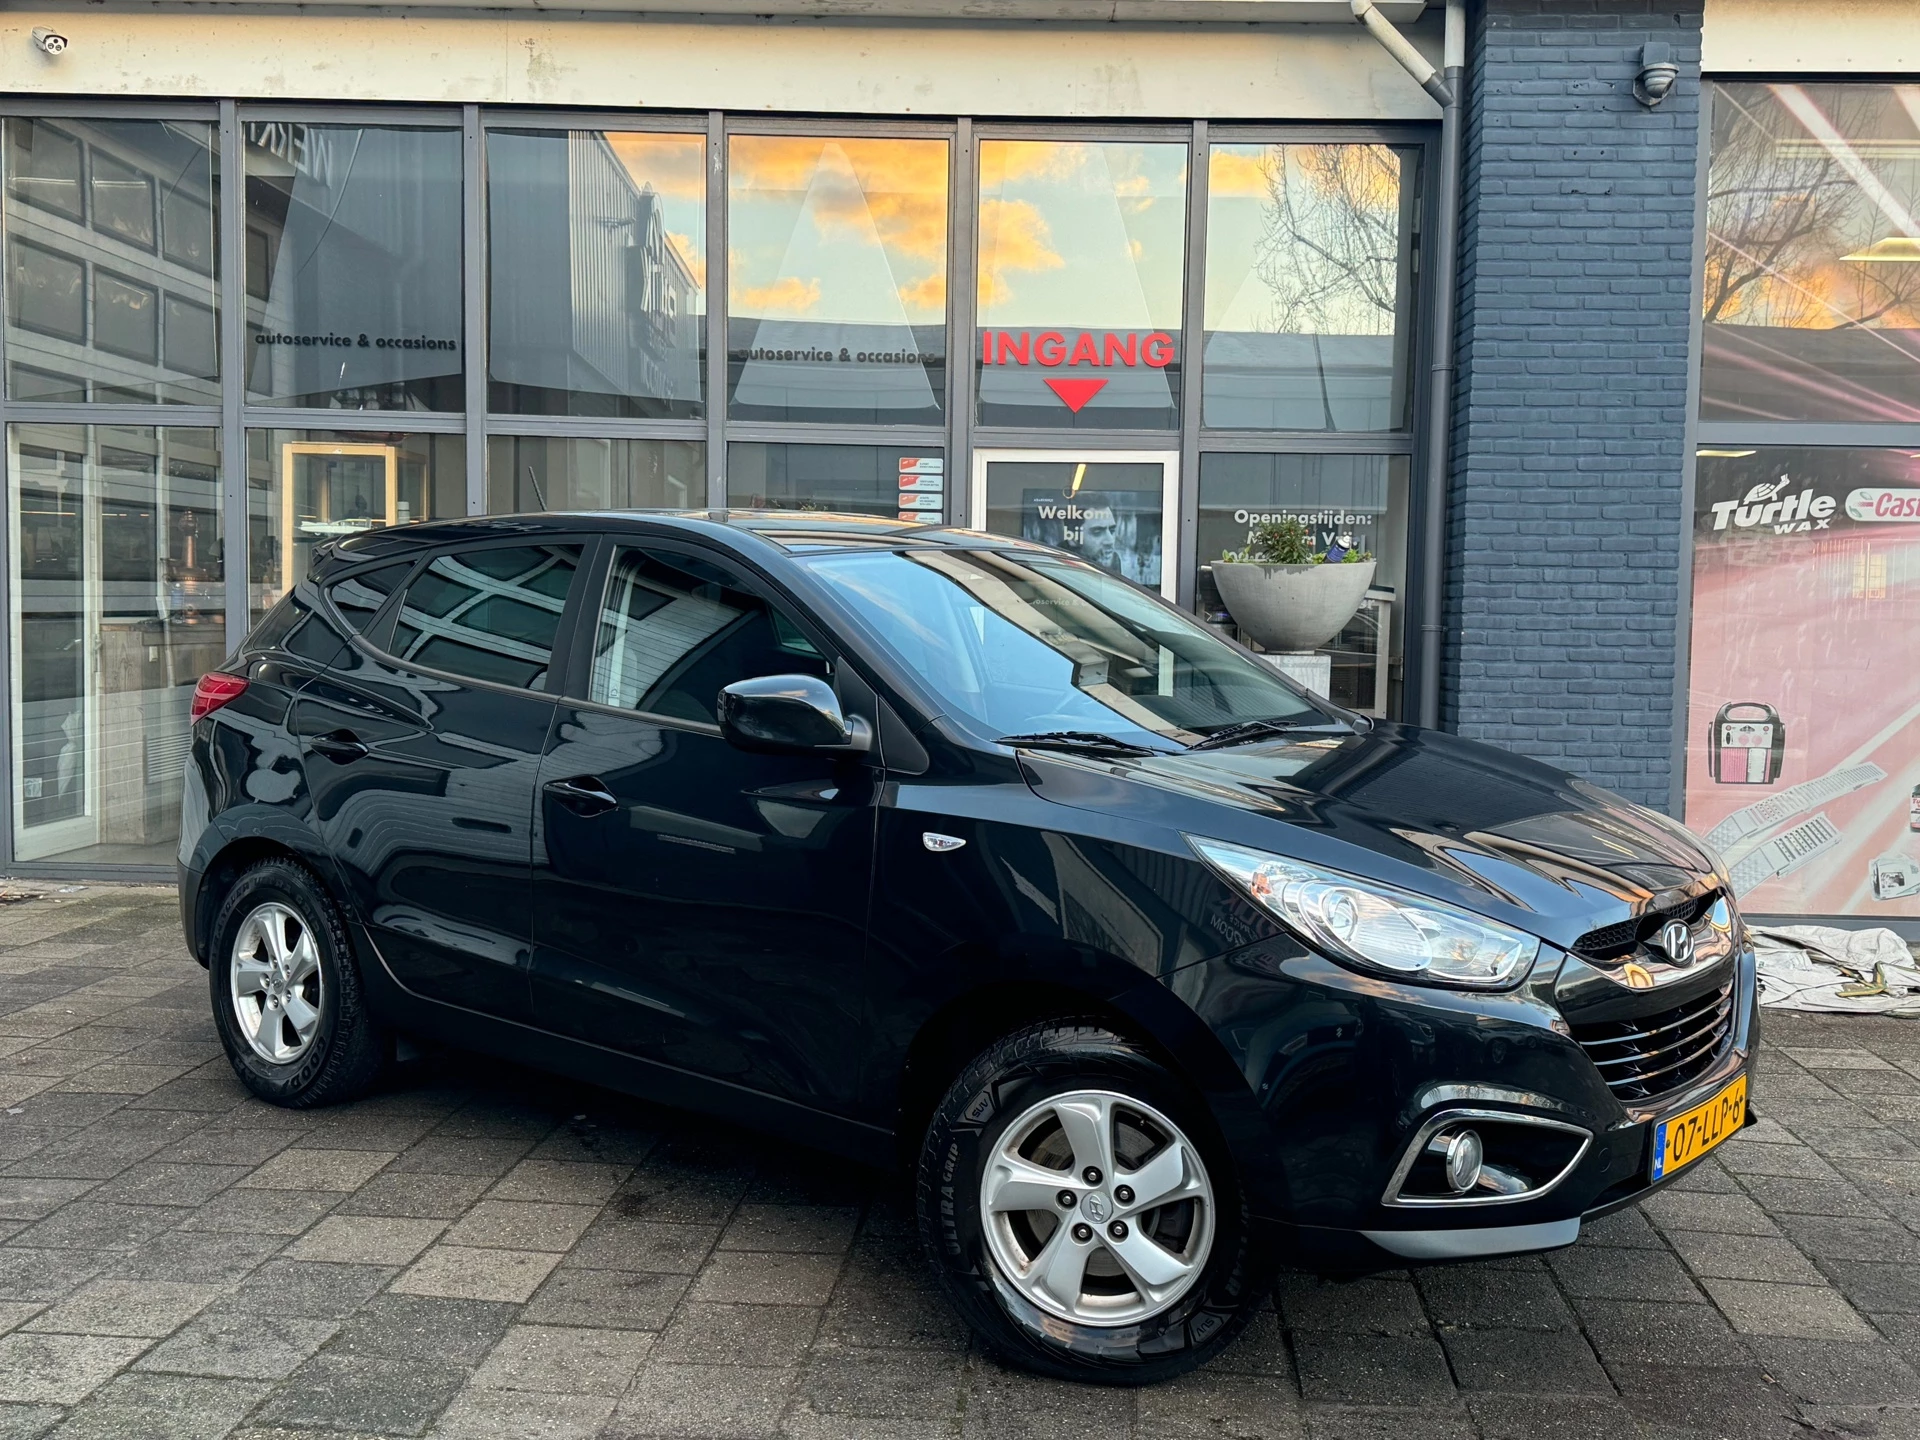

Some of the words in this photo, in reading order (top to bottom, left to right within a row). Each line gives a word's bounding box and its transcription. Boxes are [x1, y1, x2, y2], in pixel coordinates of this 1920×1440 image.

[255, 332, 352, 347] autoservice
[357, 333, 370, 348] &
[376, 335, 457, 351] occasions
[983, 331, 1175, 368] INGANG
[738, 346, 833, 362] autoservice
[838, 347, 851, 363] &
[857, 348, 936, 364] occasions
[1038, 504, 1111, 520] Welkom
[1234, 509, 1372, 529] Openingstijden:
[1711, 489, 1837, 531] Turtle
[1064, 525, 1084, 545] bij
[1774, 518, 1831, 535] WAX
[972, 1098, 989, 1118] SUV
[1673, 1087, 1740, 1162] 07-LLP-6
[942, 1142, 958, 1182] GRIP
[1654, 1156, 1662, 1171] NL
[940, 1186, 961, 1255] ULTRA
[1196, 1317, 1215, 1337] SUV
